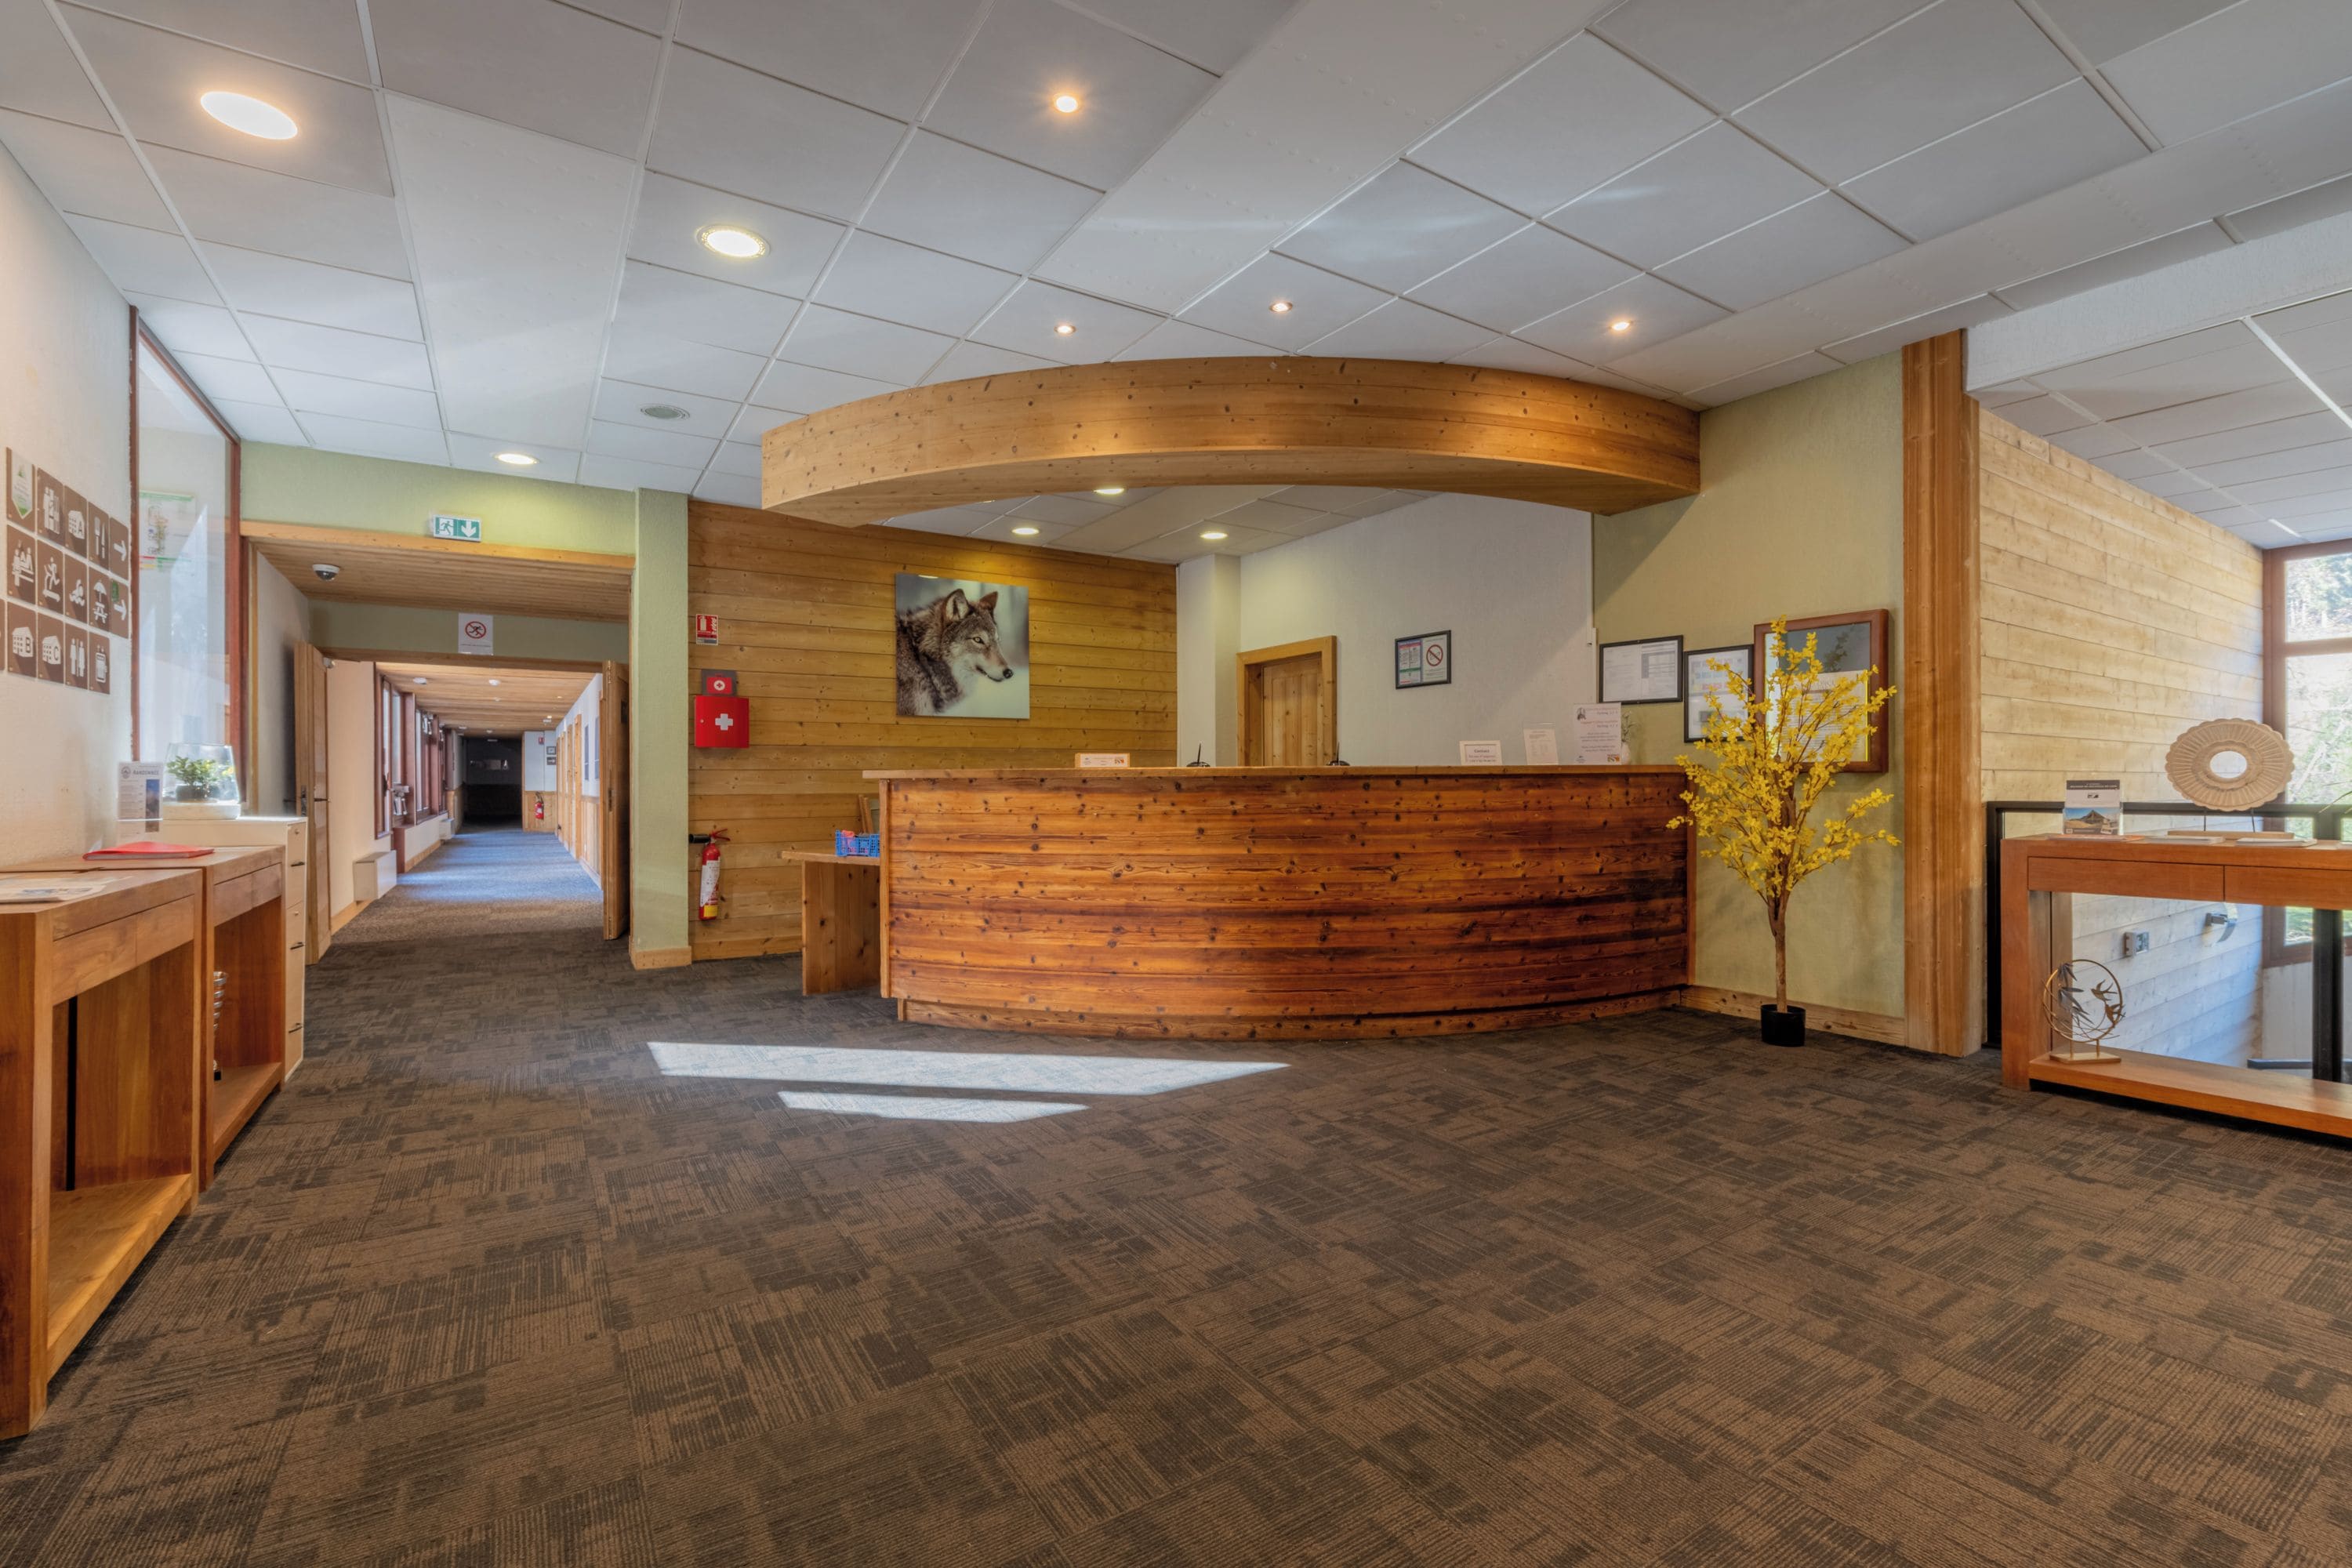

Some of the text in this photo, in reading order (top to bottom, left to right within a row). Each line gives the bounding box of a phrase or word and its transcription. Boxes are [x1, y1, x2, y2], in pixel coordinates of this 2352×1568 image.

[78, 521, 84, 535] A
[25, 636, 31, 653] B
[54, 646, 60, 661] C
